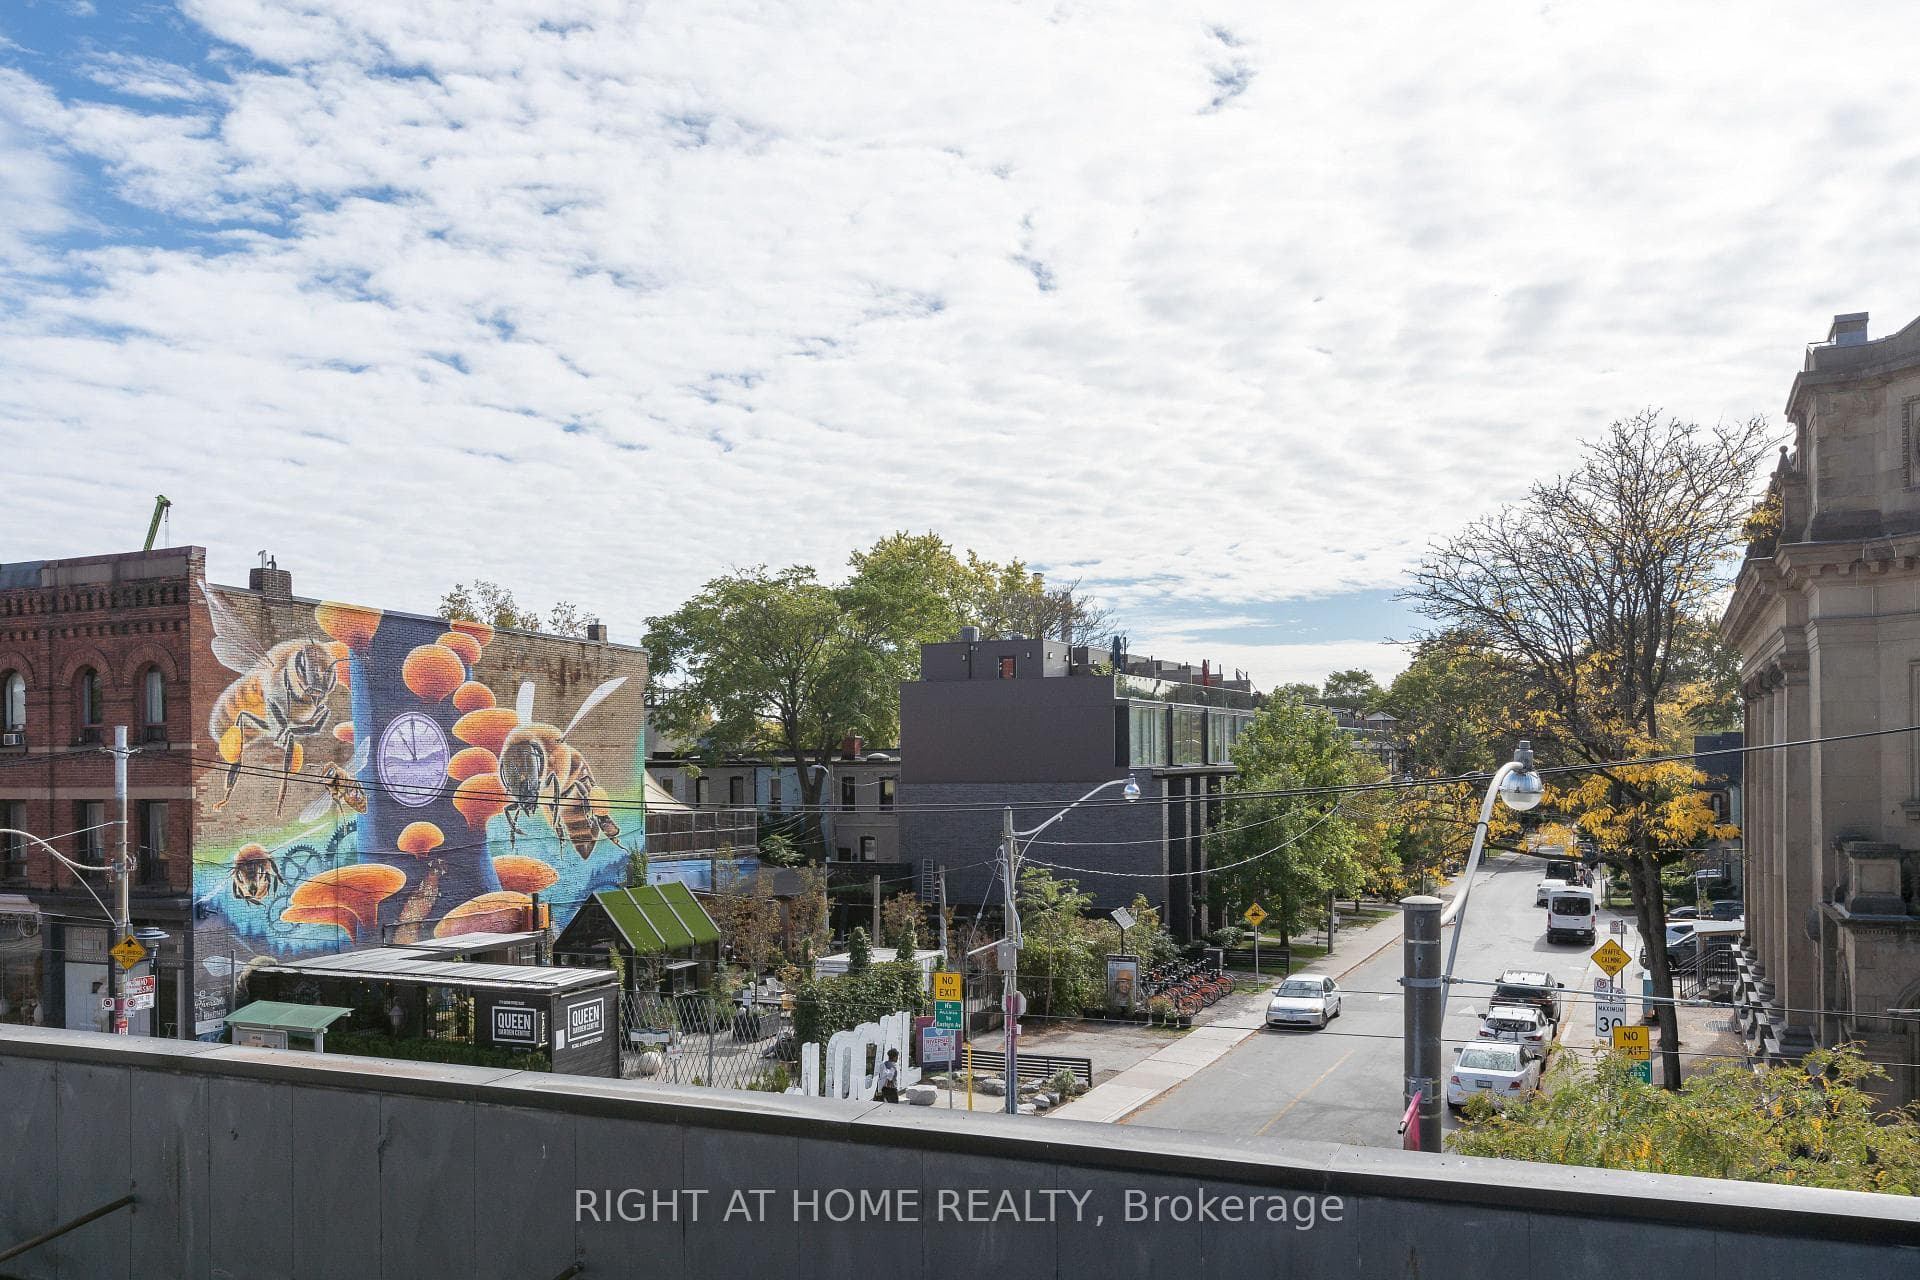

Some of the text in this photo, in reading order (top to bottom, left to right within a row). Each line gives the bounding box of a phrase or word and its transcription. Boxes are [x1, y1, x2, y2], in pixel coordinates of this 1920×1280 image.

[942, 976, 953, 984] NO
[939, 988, 957, 997] EXIT
[1598, 1005, 1624, 1013] MAXIMUM
[572, 1005, 600, 1026] QUEEN
[497, 1012, 531, 1030] QUEEN
[1599, 1016, 1623, 1032] 30
[1623, 1031, 1639, 1041] NO
